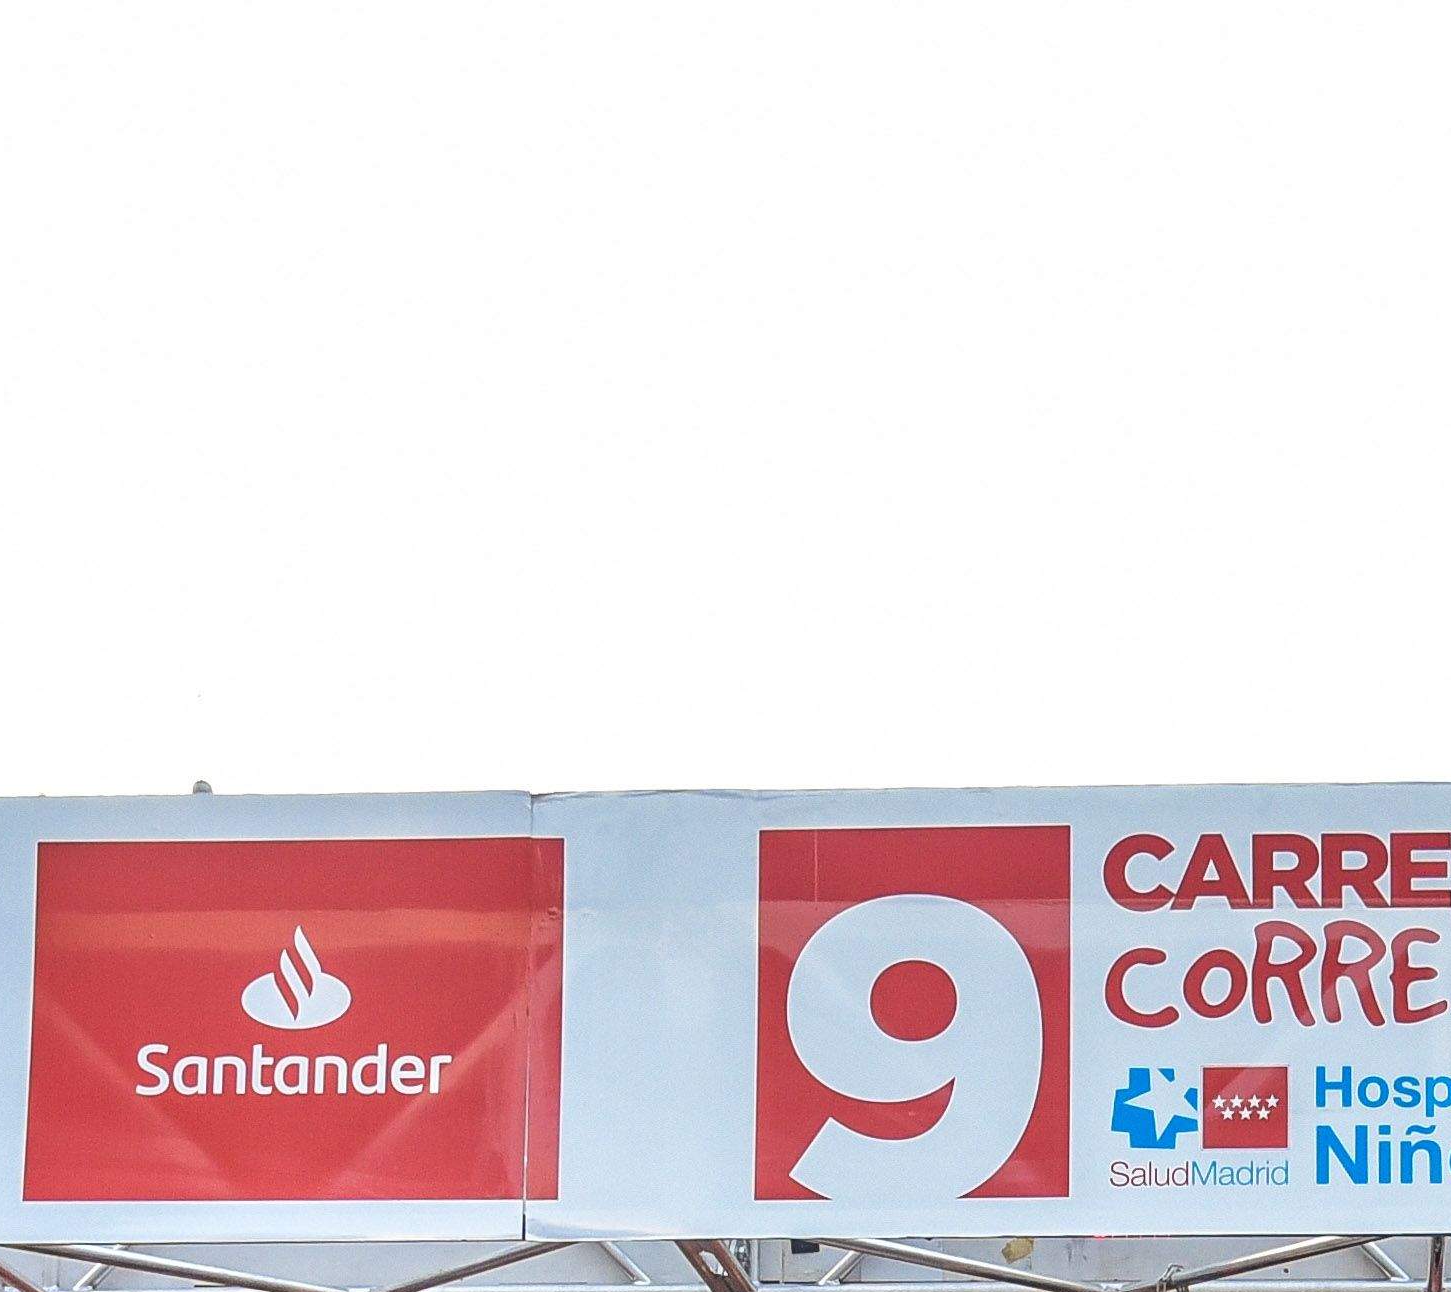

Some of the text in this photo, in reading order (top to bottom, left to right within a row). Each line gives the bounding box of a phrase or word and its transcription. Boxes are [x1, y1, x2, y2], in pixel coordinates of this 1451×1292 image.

[1104, 920, 1447, 1029] CORRE
[135, 1042, 453, 1097] Santander
[786, 893, 1044, 1199] 9
